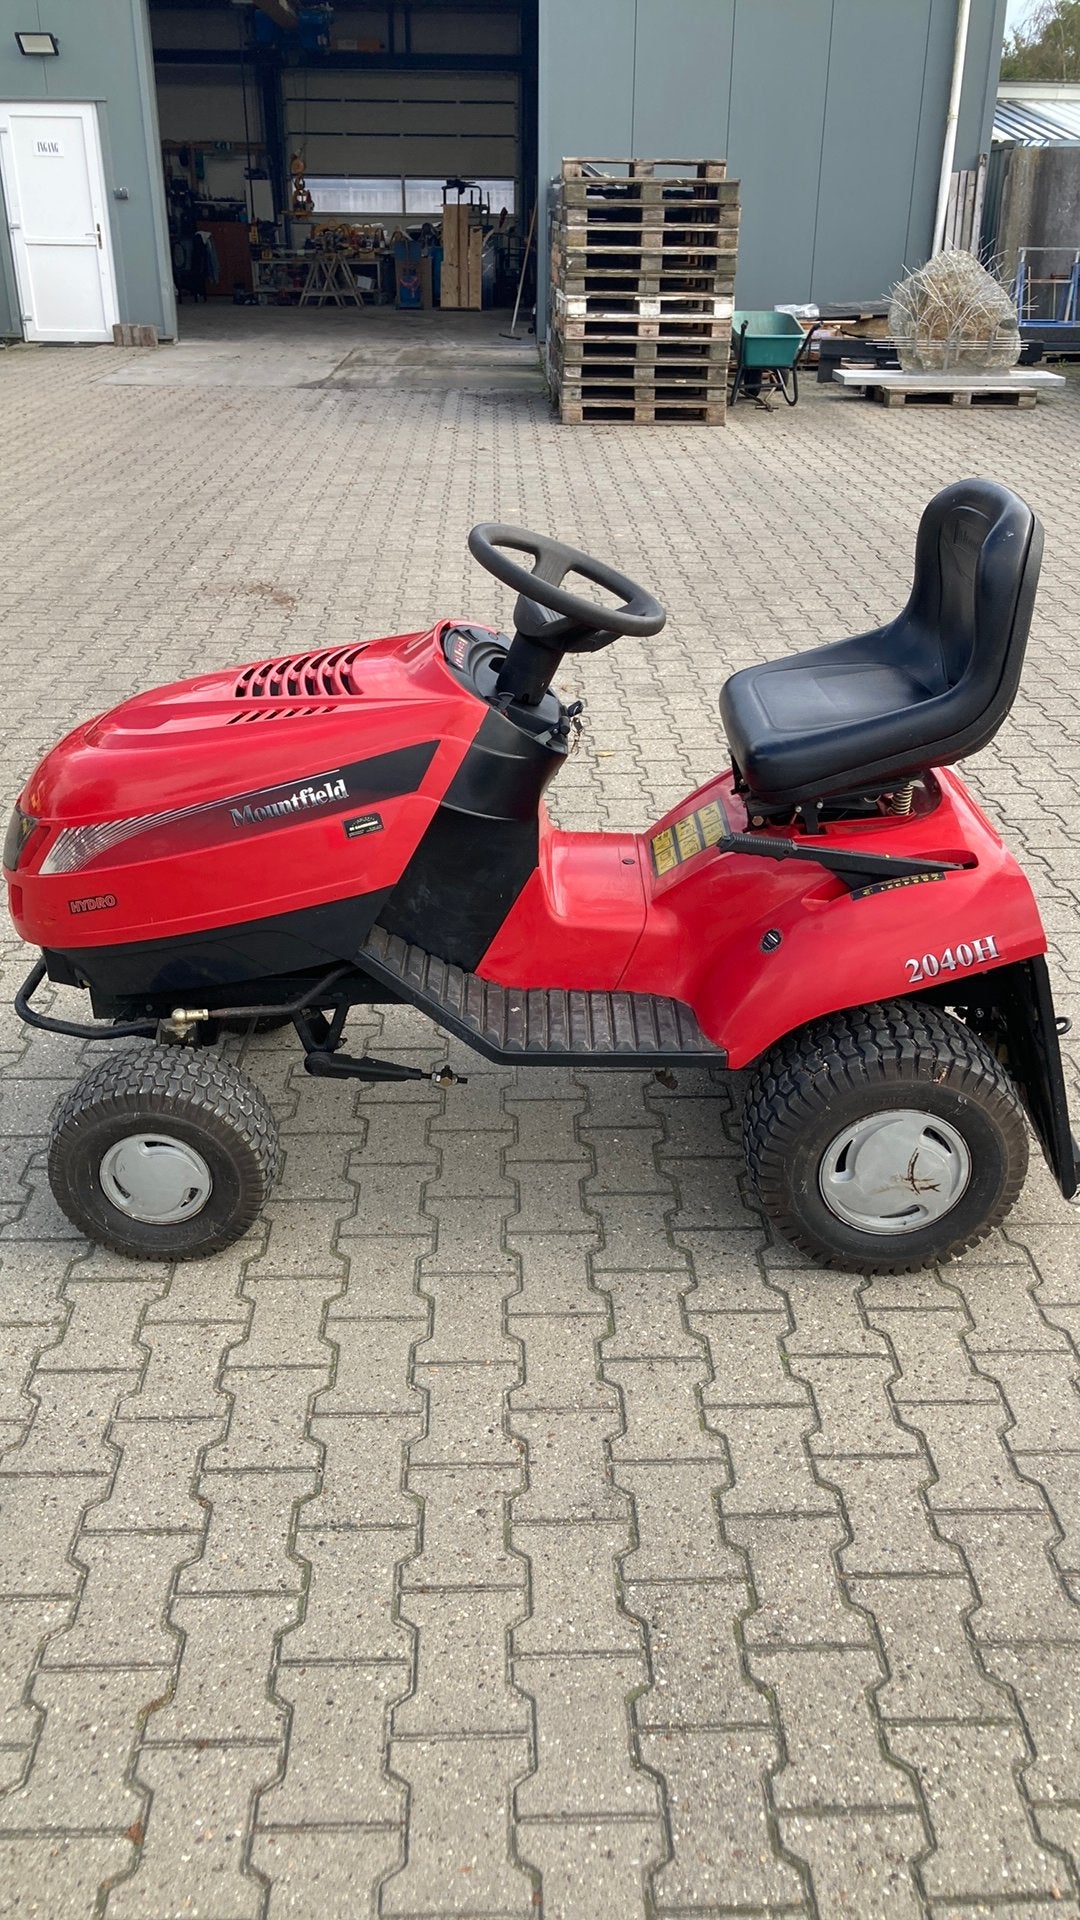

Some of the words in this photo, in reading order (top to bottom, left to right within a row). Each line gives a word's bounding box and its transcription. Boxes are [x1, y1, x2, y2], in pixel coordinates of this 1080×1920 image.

[36, 141, 59, 153] INGANG
[229, 778, 349, 827] Mountfield
[69, 894, 117, 914] HYDRO
[904, 934, 1000, 983] 2040H
